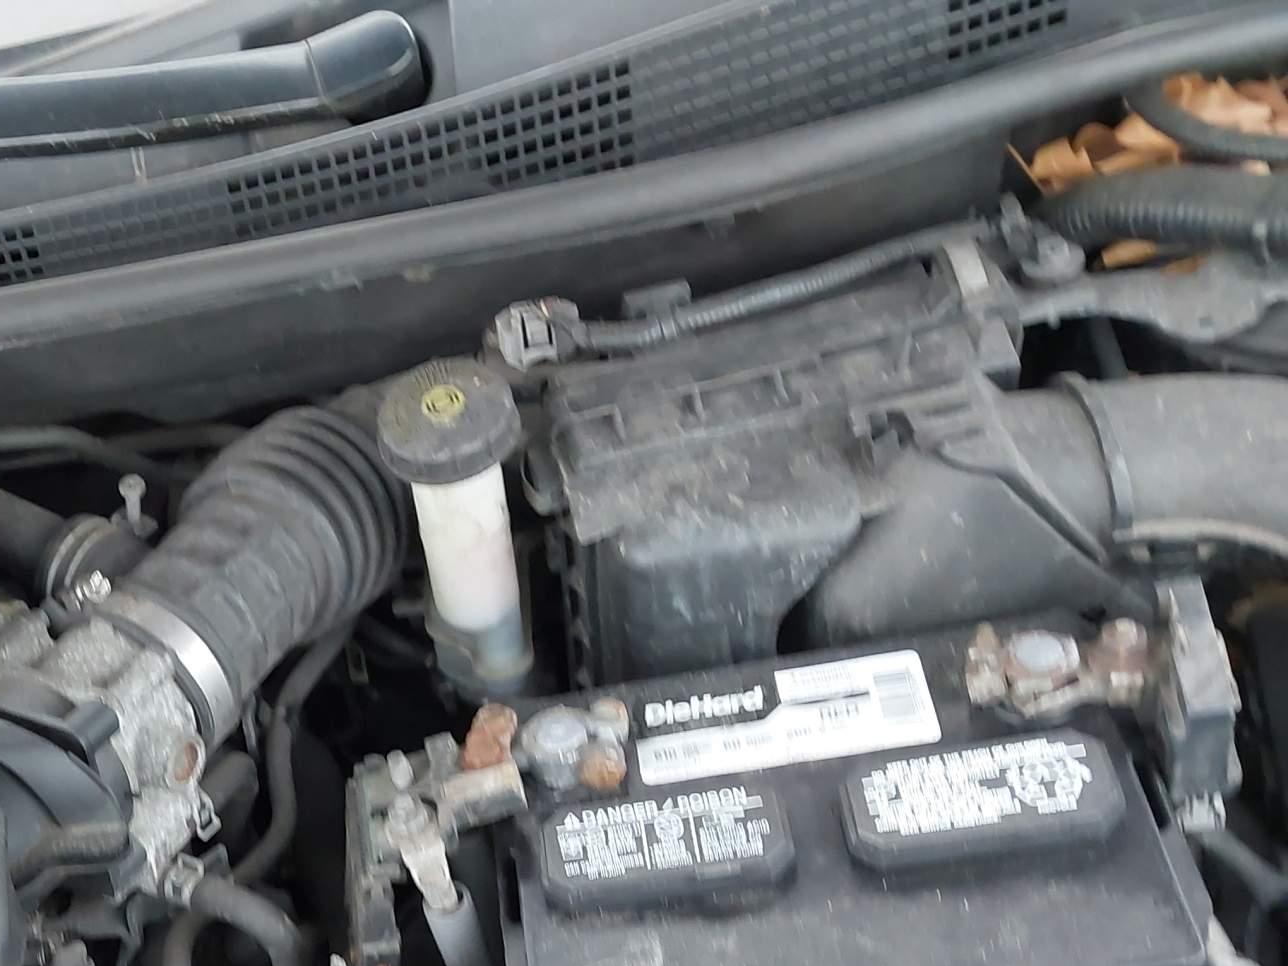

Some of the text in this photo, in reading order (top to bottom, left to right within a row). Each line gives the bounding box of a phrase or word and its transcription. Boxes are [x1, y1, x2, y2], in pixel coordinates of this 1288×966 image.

[644, 684, 764, 728] DieHard
[582, 800, 659, 825] DANGER
[677, 786, 747, 813] POISON
